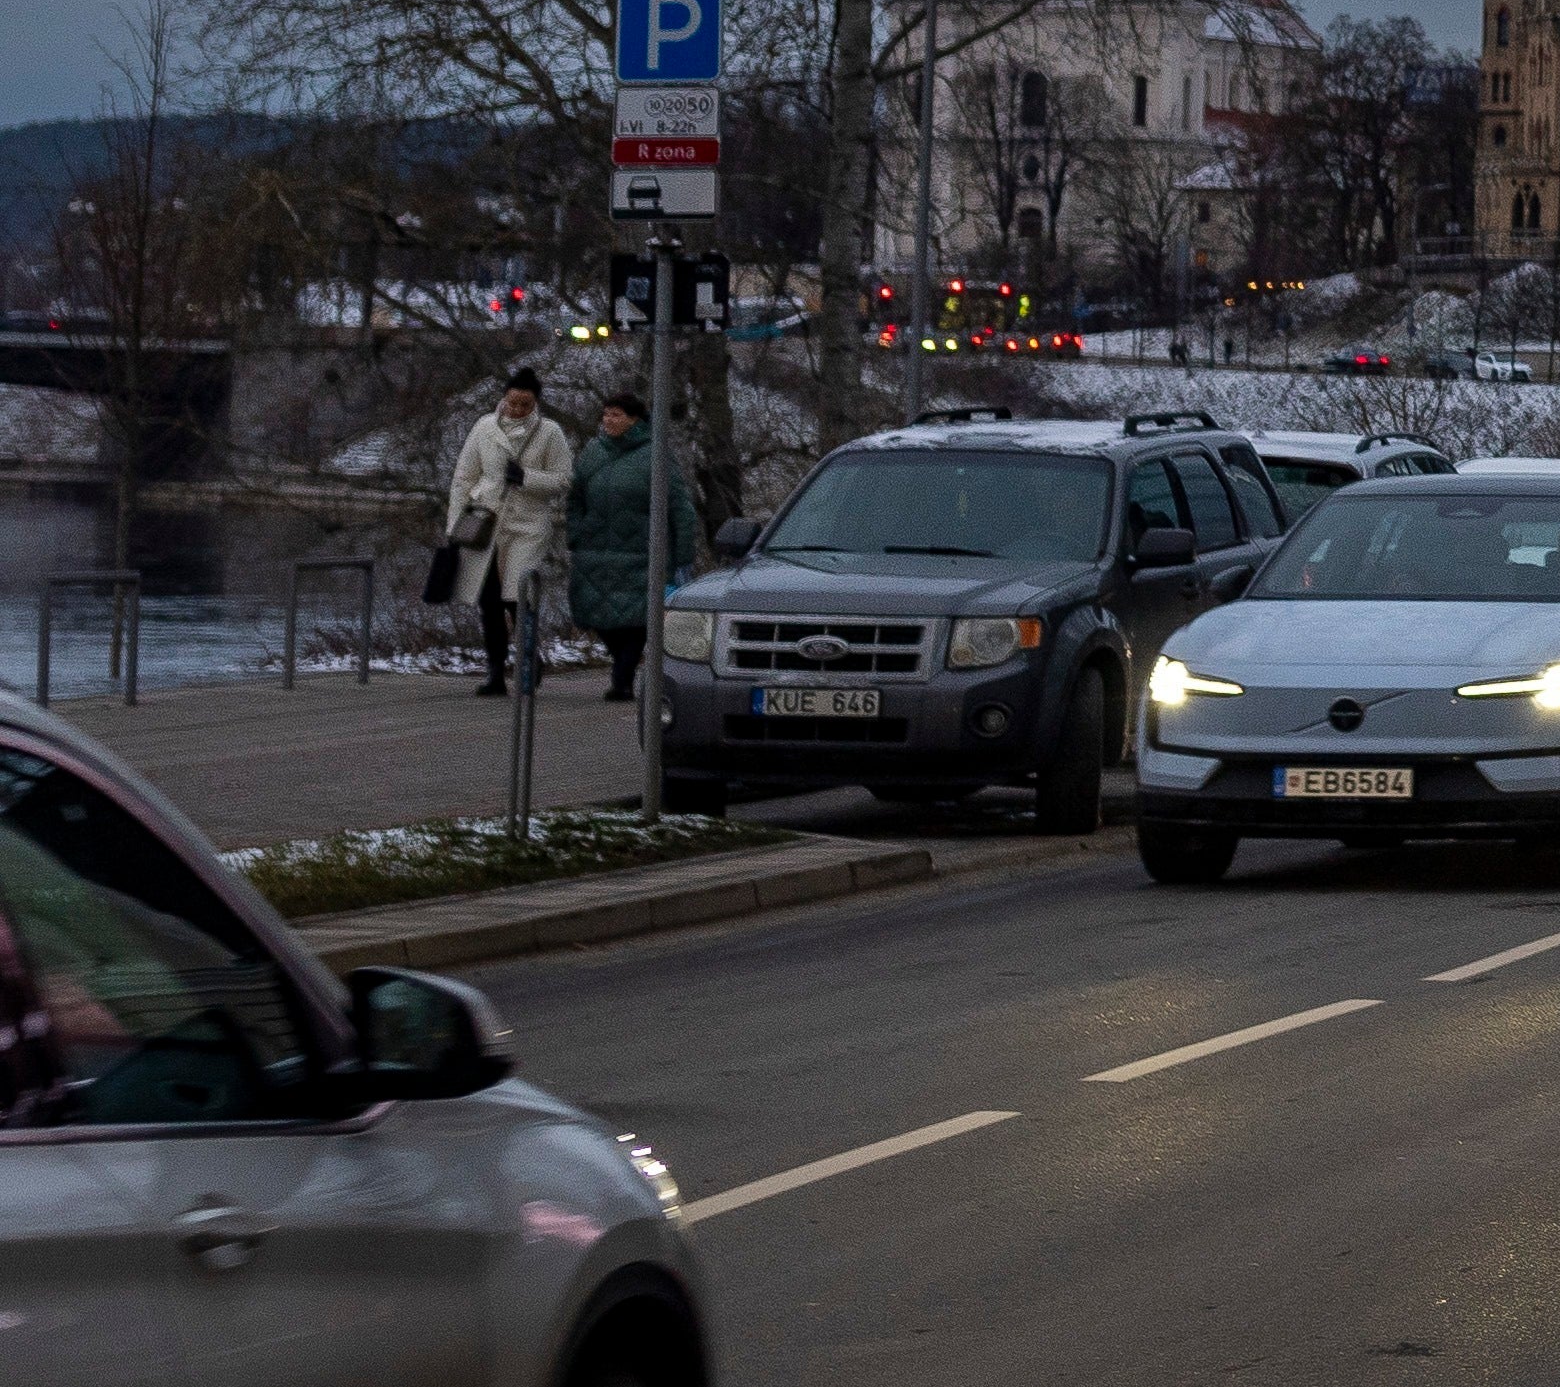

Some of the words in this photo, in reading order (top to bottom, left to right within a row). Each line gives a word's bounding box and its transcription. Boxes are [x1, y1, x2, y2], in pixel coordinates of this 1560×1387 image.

[666, 98, 681, 110] 20
[687, 97, 709, 113] 50
[638, 144, 649, 159] R
[655, 146, 697, 160] zona
[766, 691, 816, 712] KUE
[833, 692, 877, 714] 646
[1304, 771, 1405, 794] EB6584
